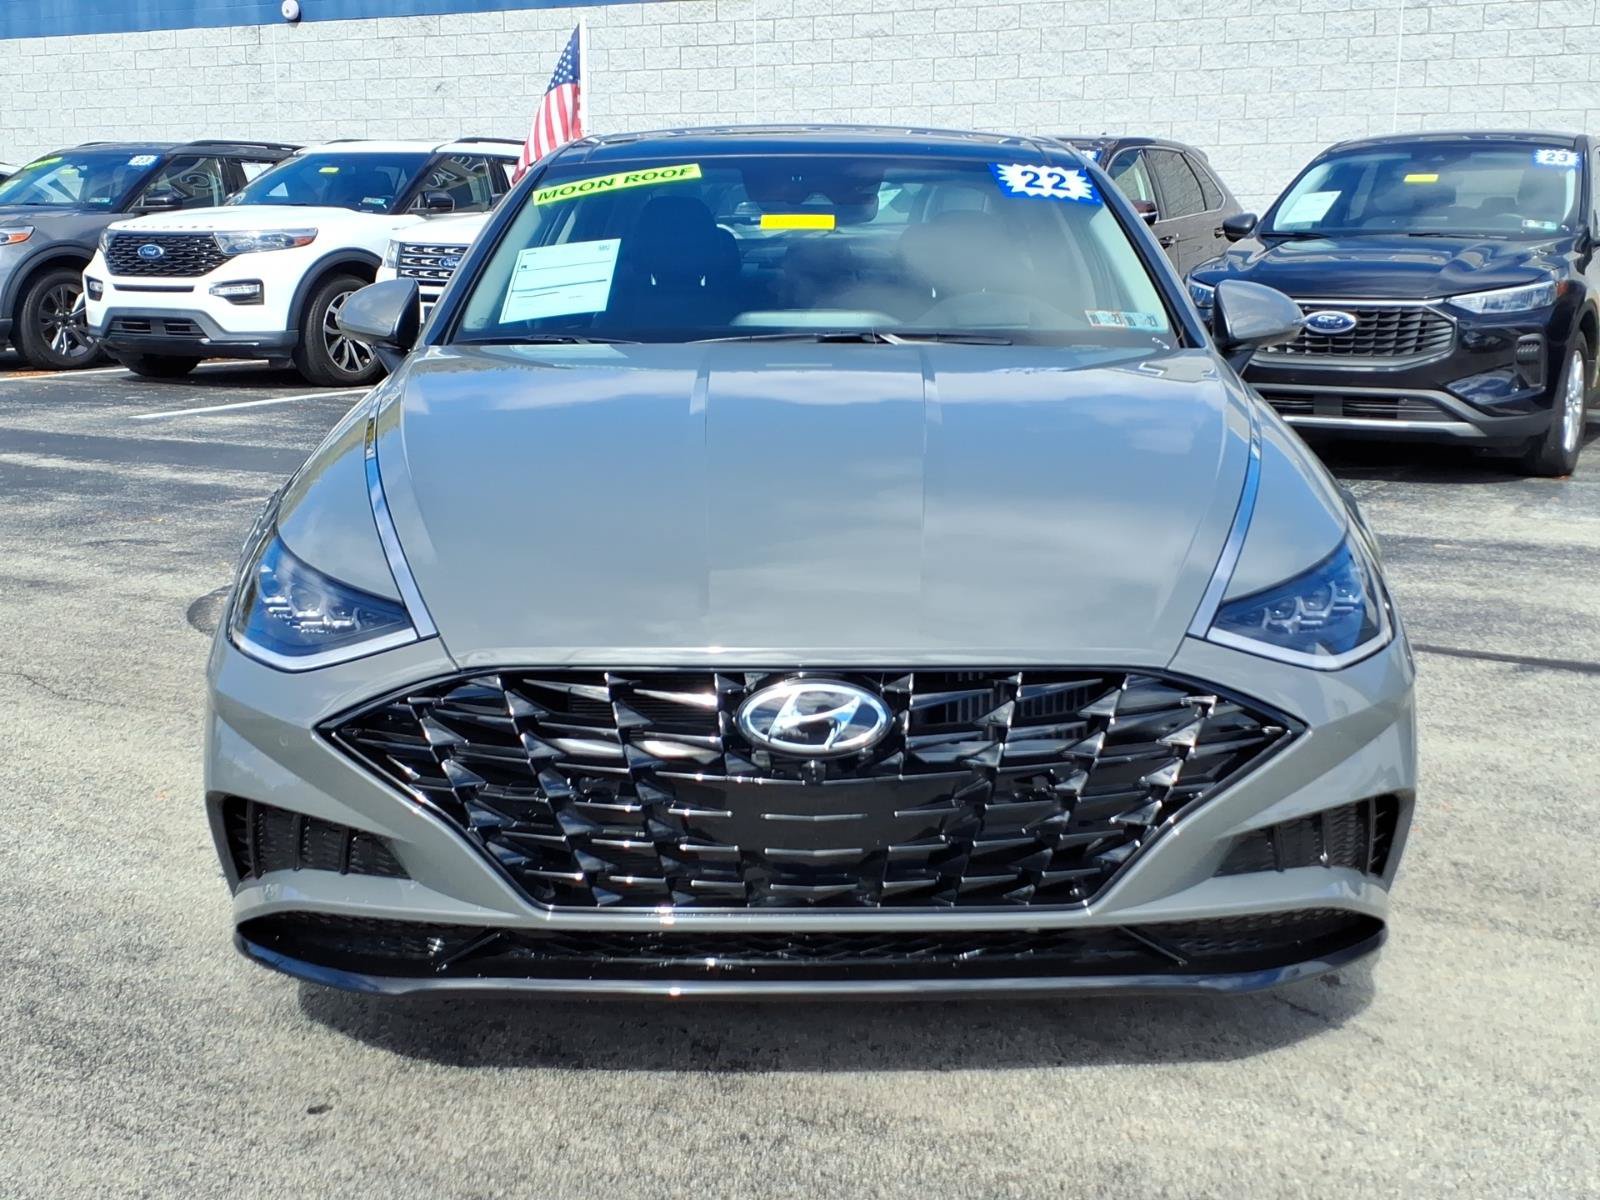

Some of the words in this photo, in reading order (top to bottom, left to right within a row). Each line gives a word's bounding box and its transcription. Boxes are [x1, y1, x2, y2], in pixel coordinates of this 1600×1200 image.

[1545, 152, 1568, 162] 23
[537, 176, 616, 202] MOON
[623, 166, 695, 185] ROOF
[1020, 170, 1071, 191] 22
